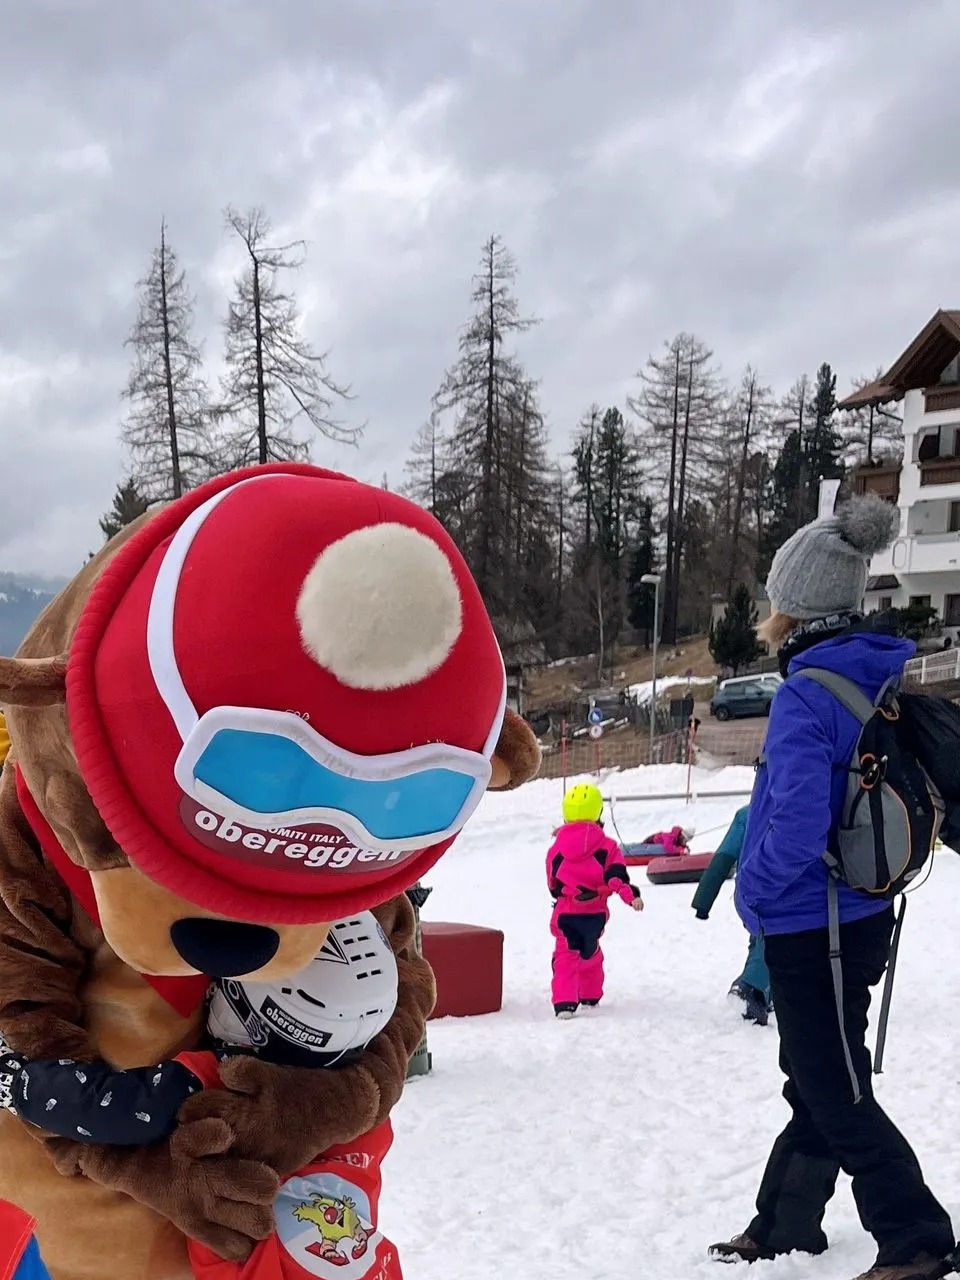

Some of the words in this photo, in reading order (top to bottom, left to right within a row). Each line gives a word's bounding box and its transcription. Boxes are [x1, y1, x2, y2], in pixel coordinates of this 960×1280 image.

[195, 810, 402, 868] obereggen
[310, 834, 343, 844] ITALY
[266, 1007, 324, 1045] obereggen
